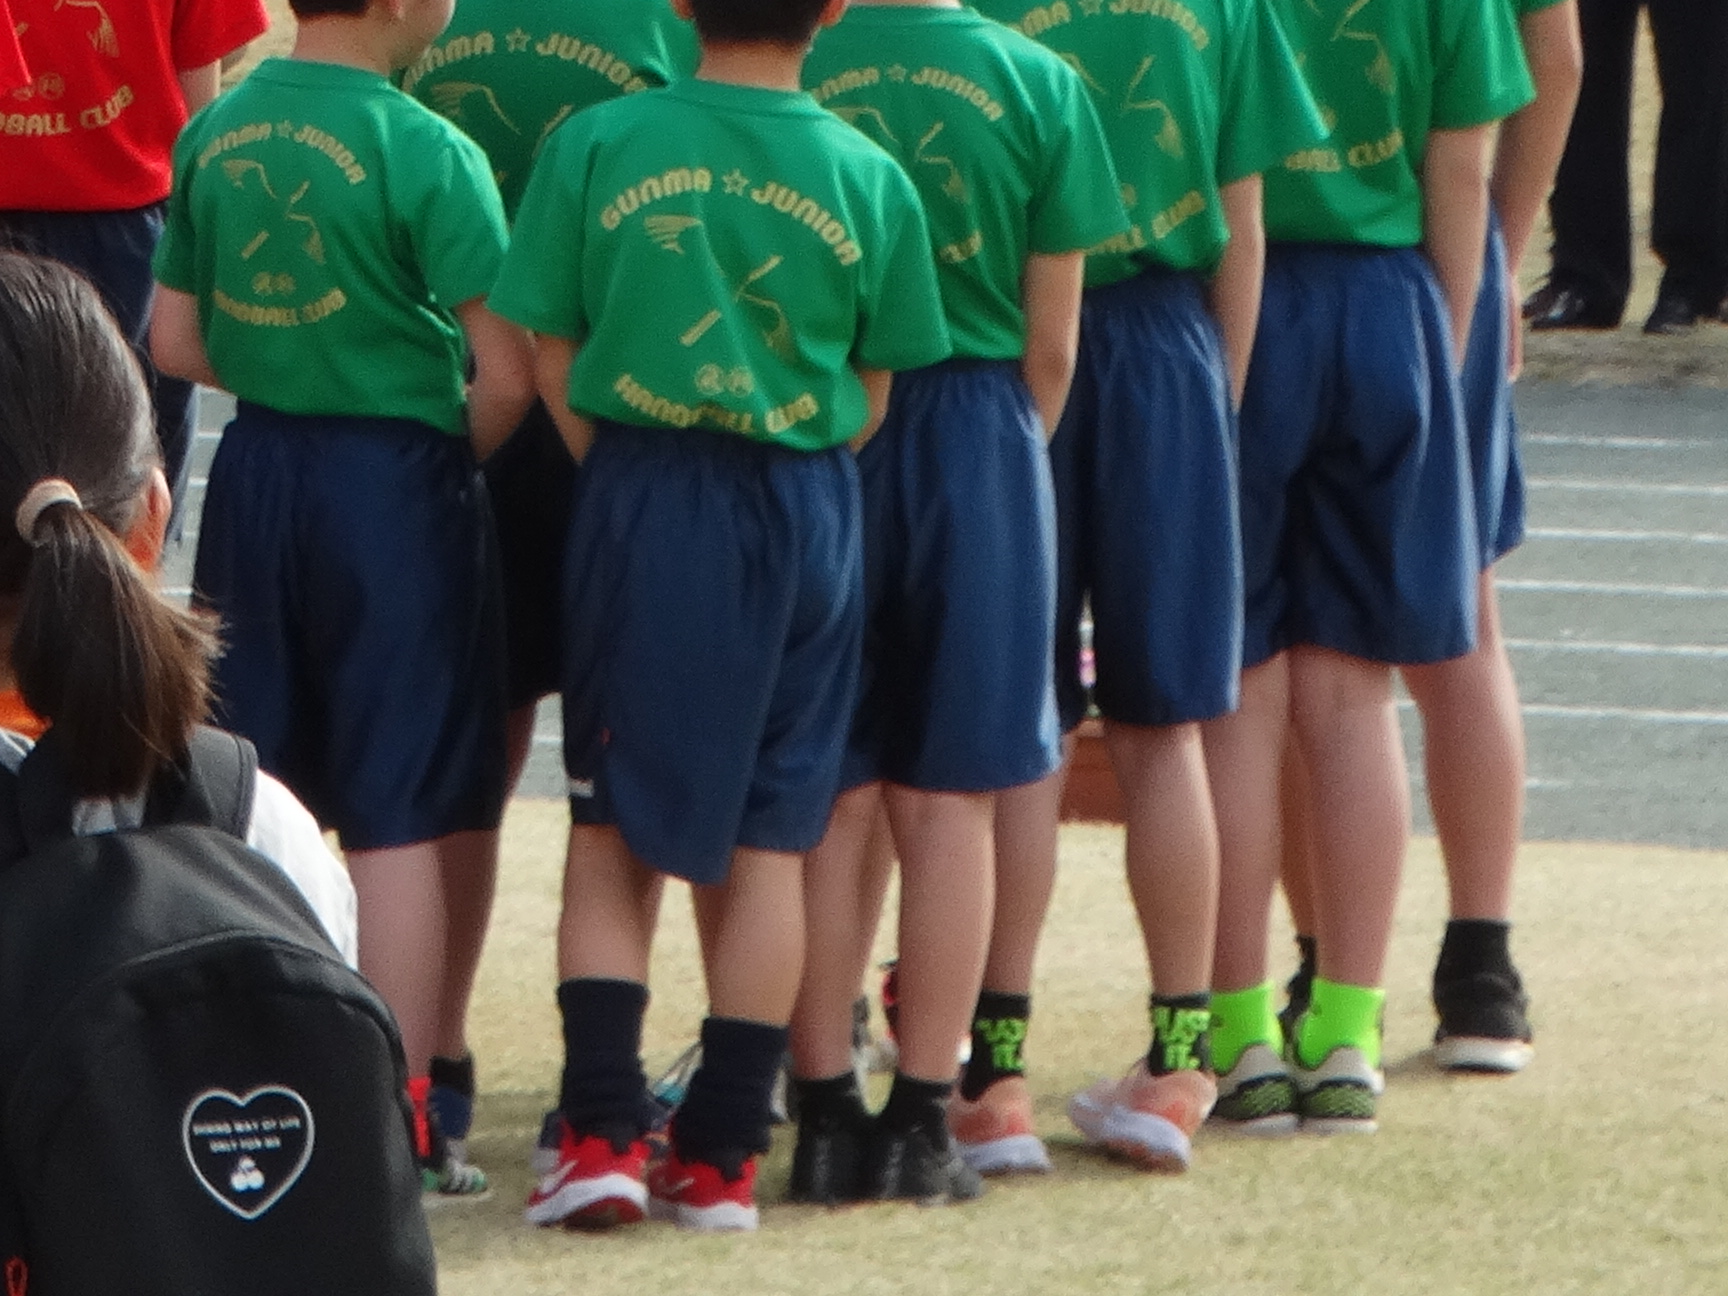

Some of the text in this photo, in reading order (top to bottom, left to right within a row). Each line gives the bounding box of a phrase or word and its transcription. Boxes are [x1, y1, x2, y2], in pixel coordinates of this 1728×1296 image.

[79, 84, 134, 130] CLUB
[293, 124, 367, 185] JUNIOR
[600, 166, 863, 267] GUNMA JUNIOR
